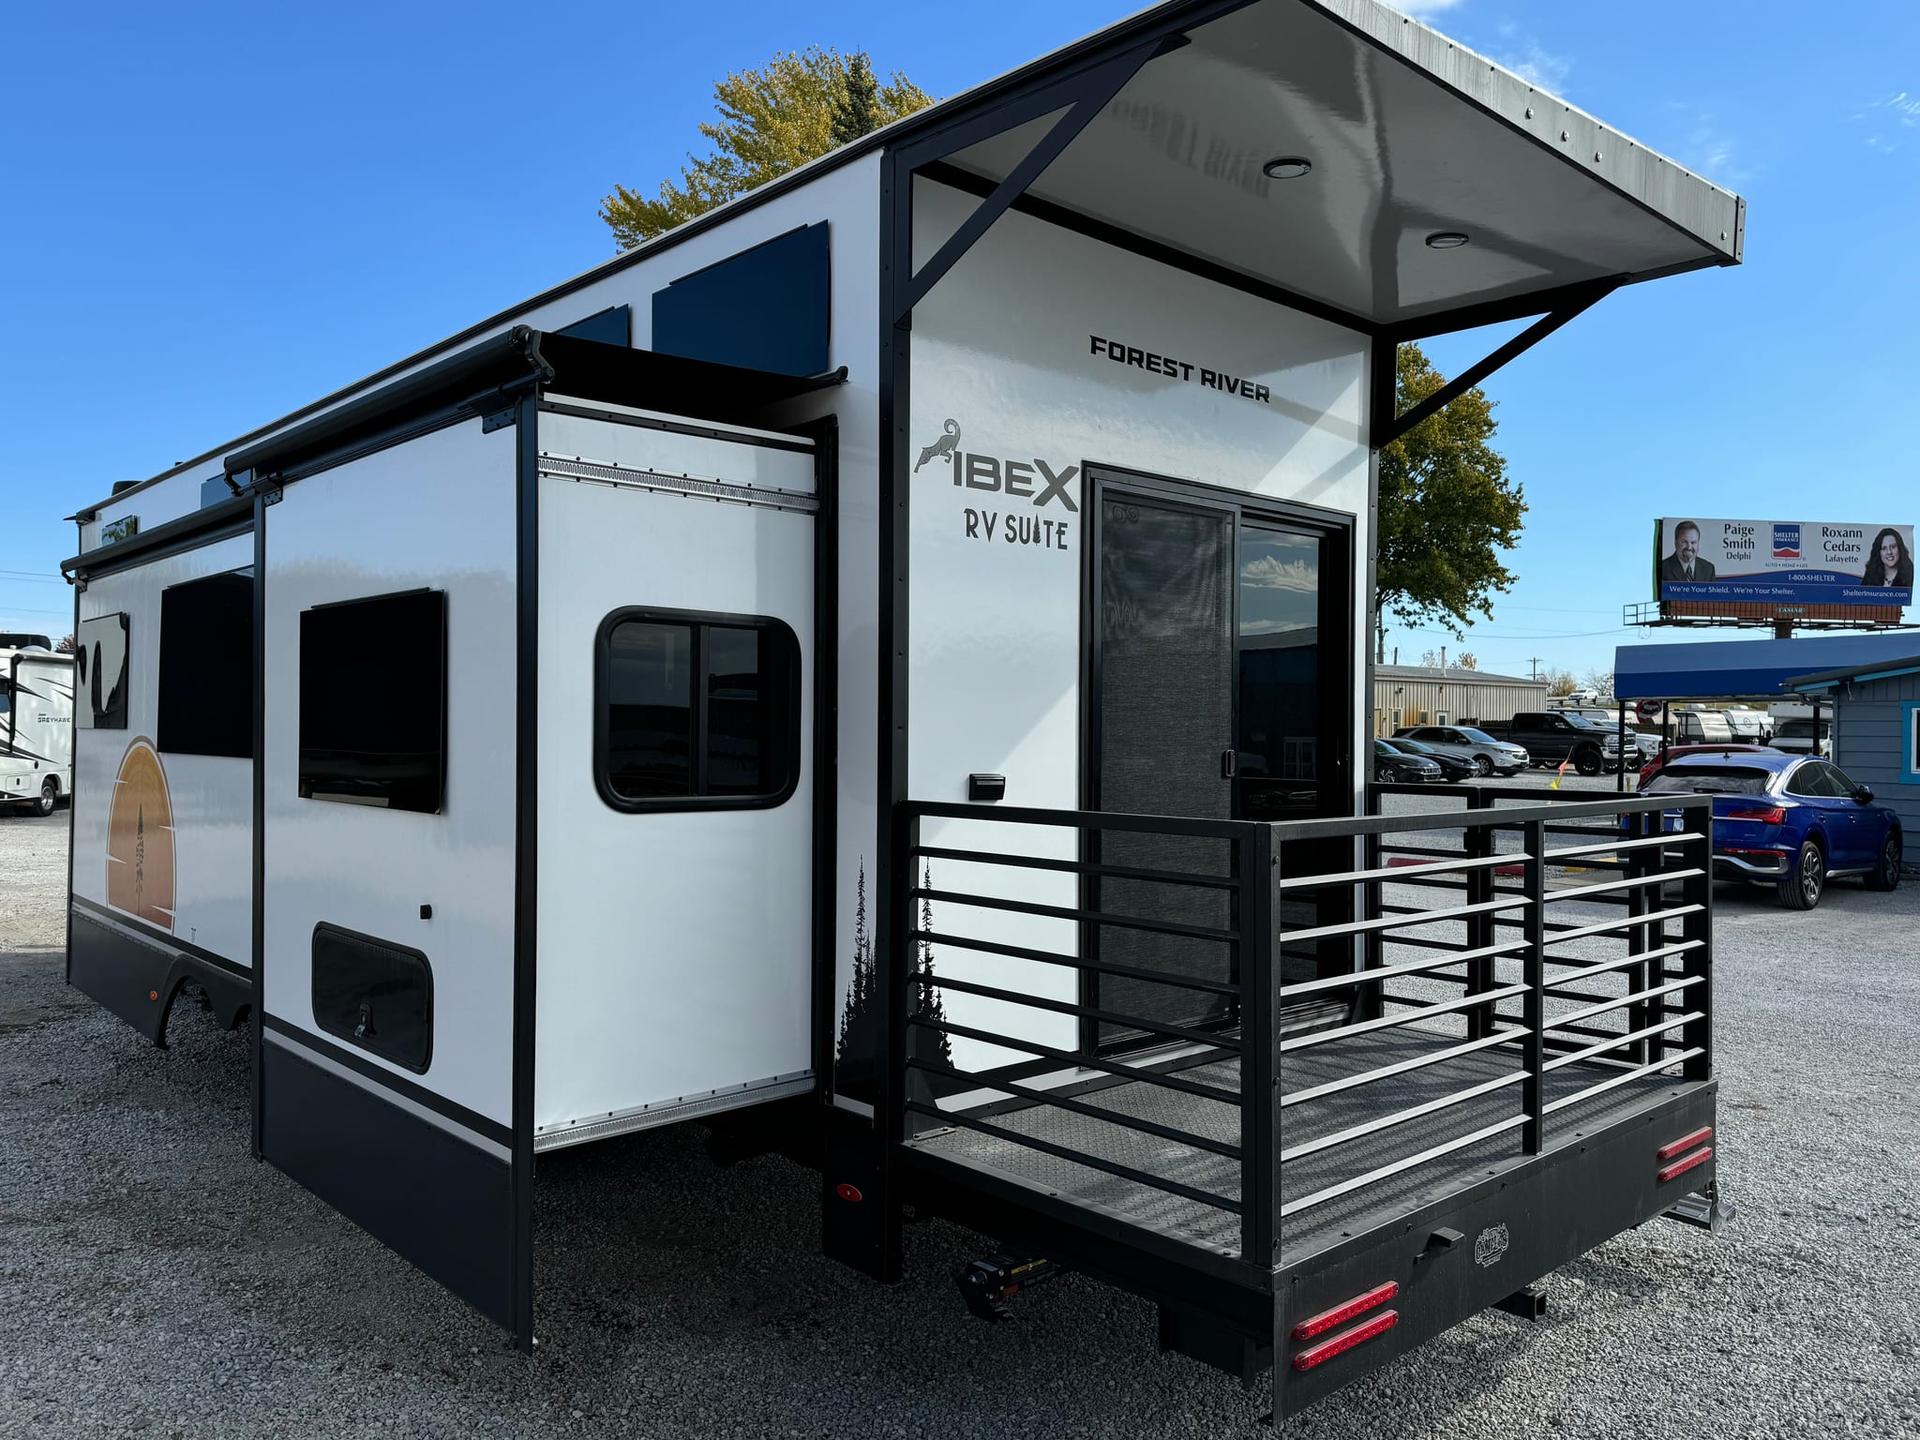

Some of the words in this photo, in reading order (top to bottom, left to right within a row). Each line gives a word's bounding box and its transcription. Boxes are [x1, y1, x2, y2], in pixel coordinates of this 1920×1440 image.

[1089, 335, 1194, 382] FOREST
[1200, 367, 1270, 404] RIVER
[953, 450, 1080, 512] IBEX
[963, 508, 998, 543] RV
[1724, 523, 1755, 537] Paige
[1822, 526, 1863, 538] Roxann
[1722, 537, 1755, 549] Smith
[1823, 540, 1861, 552] Cedars
[1726, 551, 1751, 561] Delphi
[1825, 554, 1859, 564] Lafayette
[1788, 574, 1836, 582] 1-800-SHELTER
[1771, 587, 1795, 596] Shelter.
[1842, 589, 1908, 598] ShelterInsurance.com
